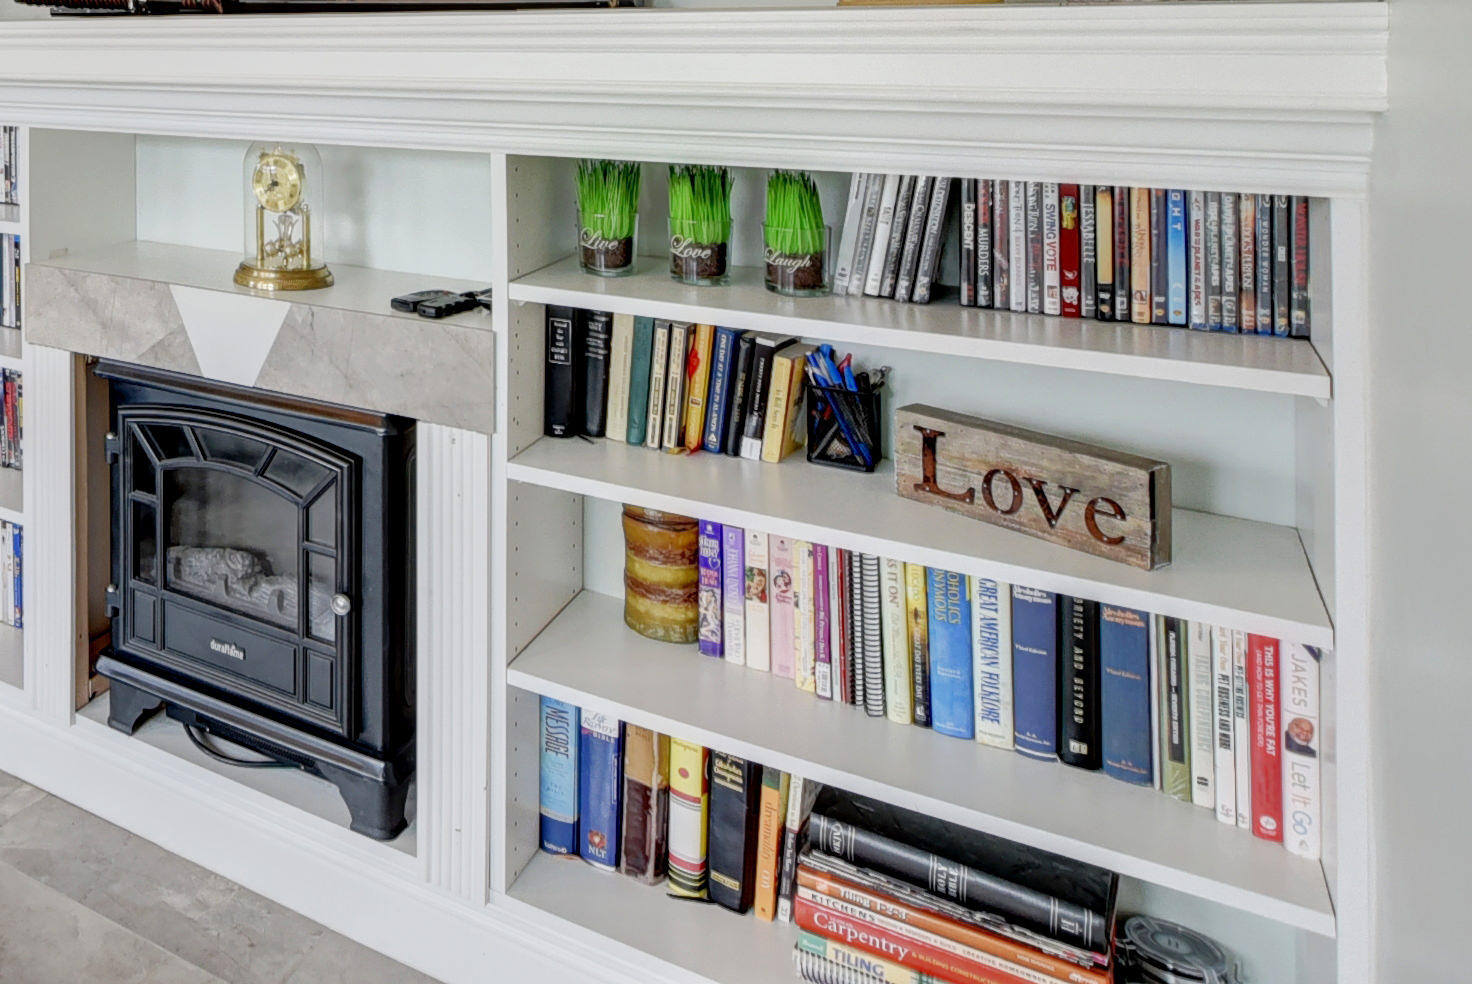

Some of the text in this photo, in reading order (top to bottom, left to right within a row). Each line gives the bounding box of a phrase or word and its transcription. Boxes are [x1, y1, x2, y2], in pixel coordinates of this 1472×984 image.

[580, 227, 618, 251] Live
[963, 202, 975, 251] DESCENT
[1045, 203, 1057, 271] SWING VOTE
[1082, 202, 1095, 263] JESSABELLE
[670, 234, 711, 260] Love
[764, 247, 813, 273] Laugh
[978, 227, 989, 276] MURDERS
[1192, 246, 1201, 276] PLANET
[1192, 284, 1201, 306] APES
[1225, 269, 1234, 292] APES
[913, 424, 1127, 546] Love
[887, 572, 898, 582] IT
[933, 568, 947, 621] ONYMOUS
[947, 573, 962, 625] OHOLICS
[210, 639, 244, 661] duraflame
[978, 578, 1000, 726] GREAT AMERICAN FOLKLORE
[1073, 597, 1084, 724] BRIETY AND BEYOND
[1219, 640, 1227, 655] Your
[913, 628, 923, 700] GREAT DAY EVERY DAY
[1219, 656, 1227, 672] Own
[1217, 674, 1230, 686] PET
[1235, 665, 1244, 695] PET-SITTING
[1291, 653, 1308, 707] JAKES
[1218, 686, 1230, 717] BUSINESS
[1235, 695, 1245, 719] BUSINESS
[1264, 645, 1276, 757] THIS IS WHY YOU'RE FAT
[545, 705, 570, 759] MESSAGE
[593, 733, 615, 743] BIBLE
[1218, 718, 1231, 731] AND
[1218, 732, 1231, 751] MORE
[1291, 761, 1312, 835] Let It Go
[589, 846, 607, 859] NLT
[937, 862, 948, 893] HOLY
[948, 867, 959, 897] BIBLE
[811, 893, 876, 922] KITCHENS
[840, 888, 870, 908] Tiling
[813, 911, 910, 961] Carpentry
[832, 947, 885, 977] TILING
